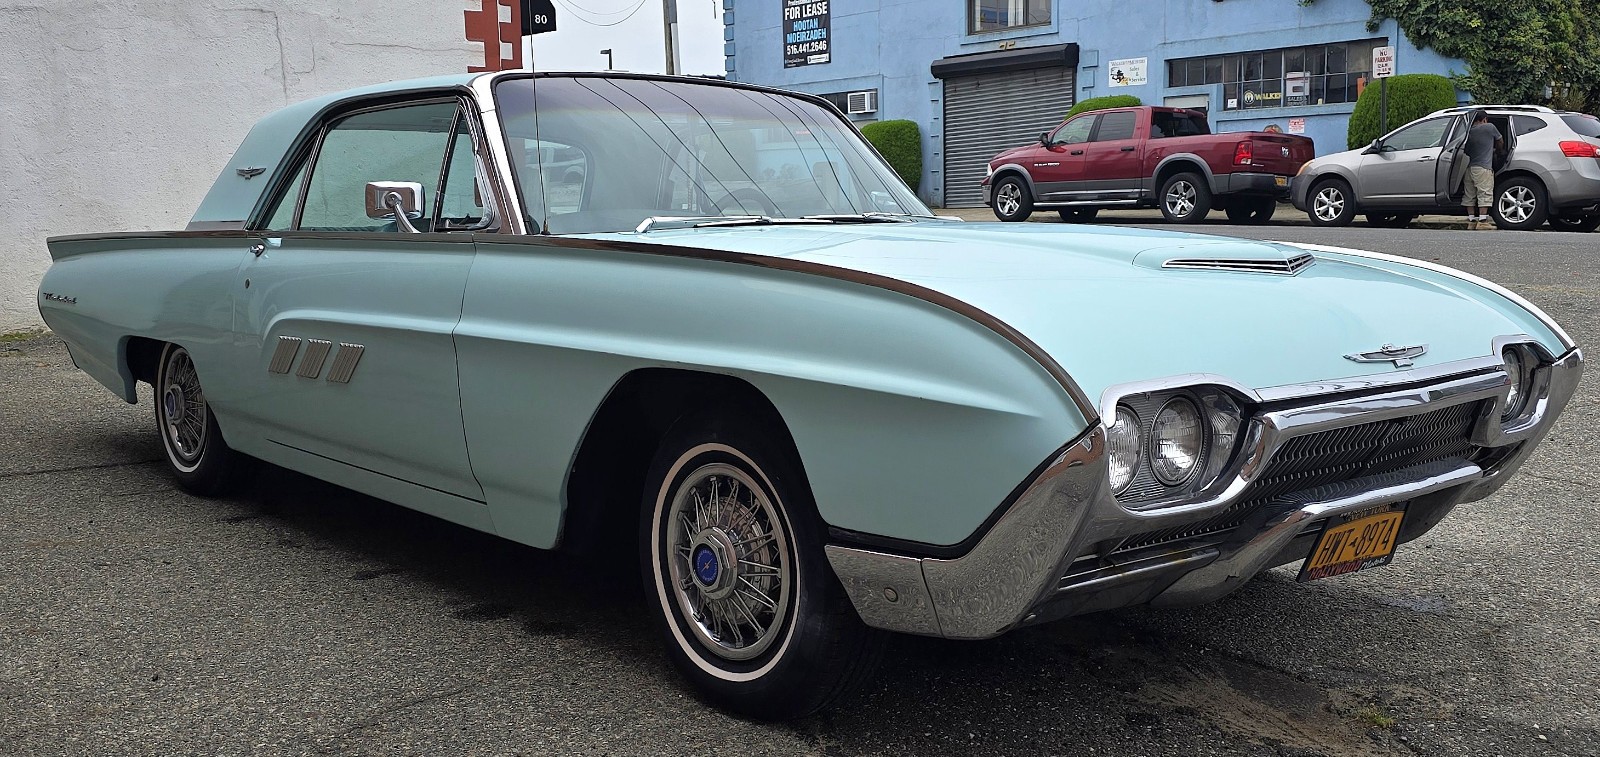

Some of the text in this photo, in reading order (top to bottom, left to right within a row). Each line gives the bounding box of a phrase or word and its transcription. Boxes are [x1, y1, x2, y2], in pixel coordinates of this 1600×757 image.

[784, 7, 801, 20] FOR
[802, 2, 828, 17] LEASE
[534, 14, 548, 24] 80
[793, 18, 819, 31] HOOTAN
[786, 40, 827, 55] 516.441.2646
